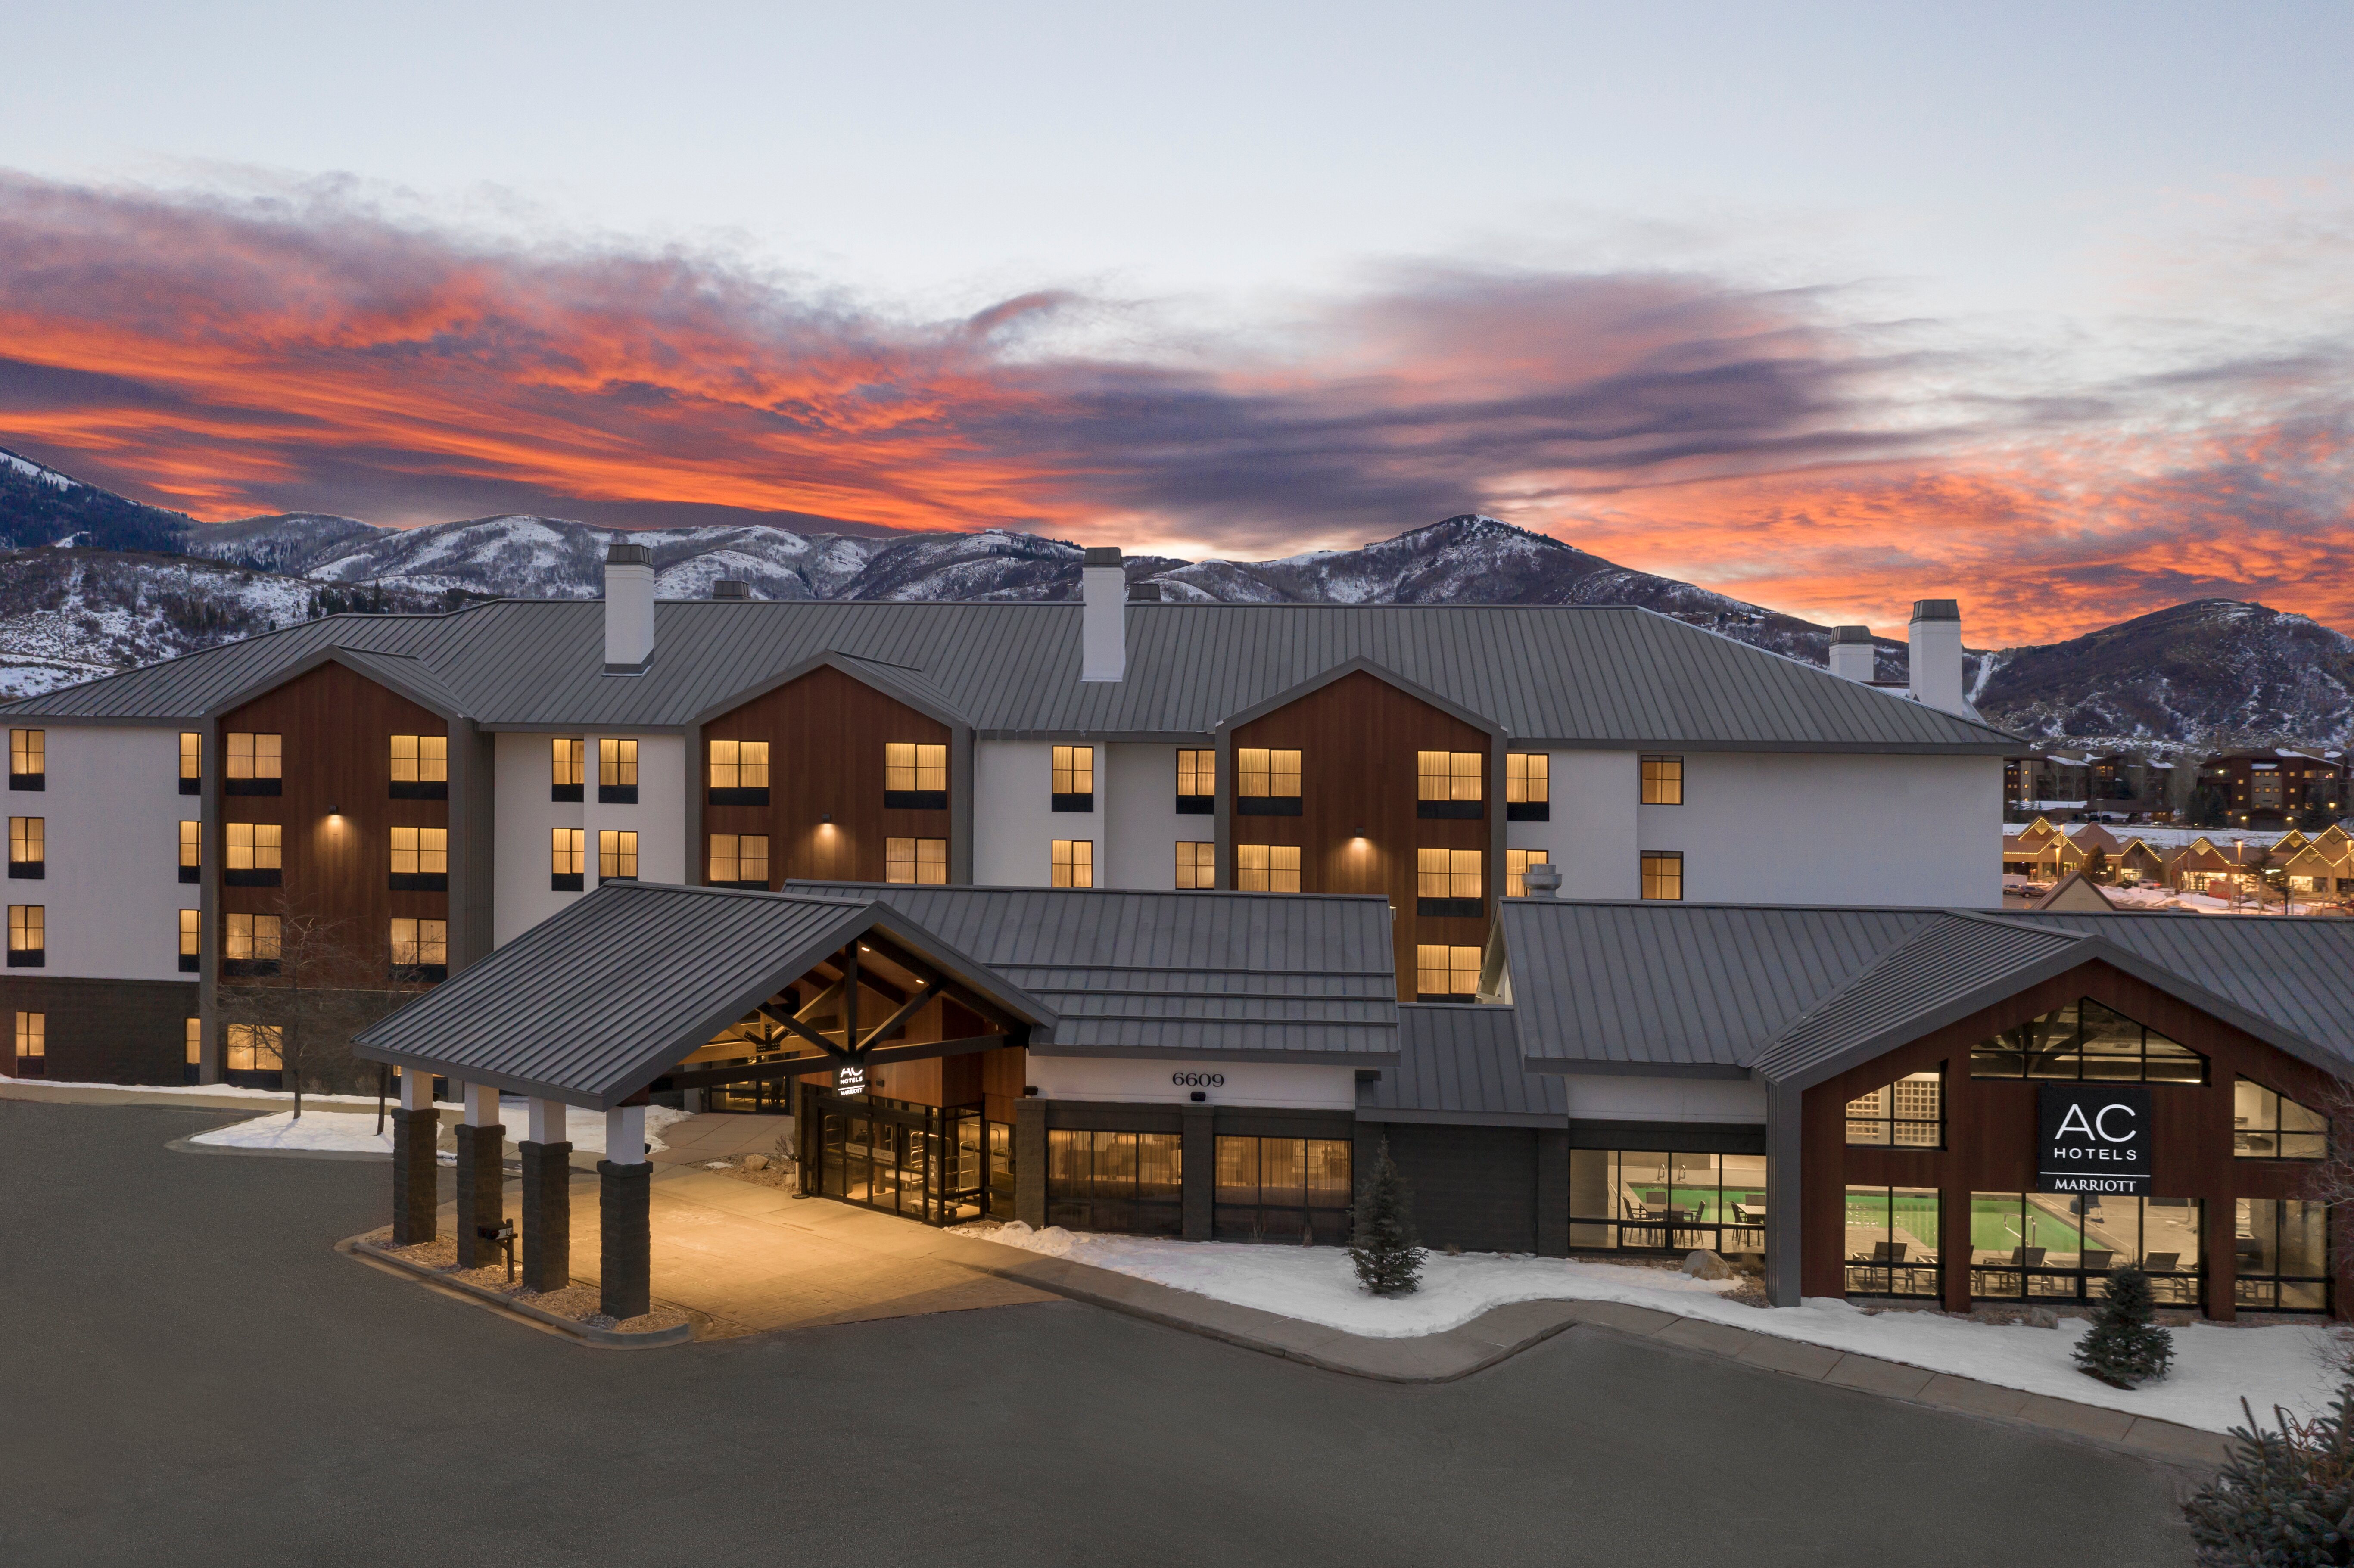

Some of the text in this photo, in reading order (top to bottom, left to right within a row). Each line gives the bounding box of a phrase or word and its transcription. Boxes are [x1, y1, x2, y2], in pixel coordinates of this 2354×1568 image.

[1172, 1072, 1224, 1087] 6609
[841, 1088, 863, 1096] MARRIOTT
[2054, 1104, 2137, 1142] AC
[2054, 1148, 2137, 1160] HOTELS
[2055, 1179, 2136, 1192] MARRIOTT
